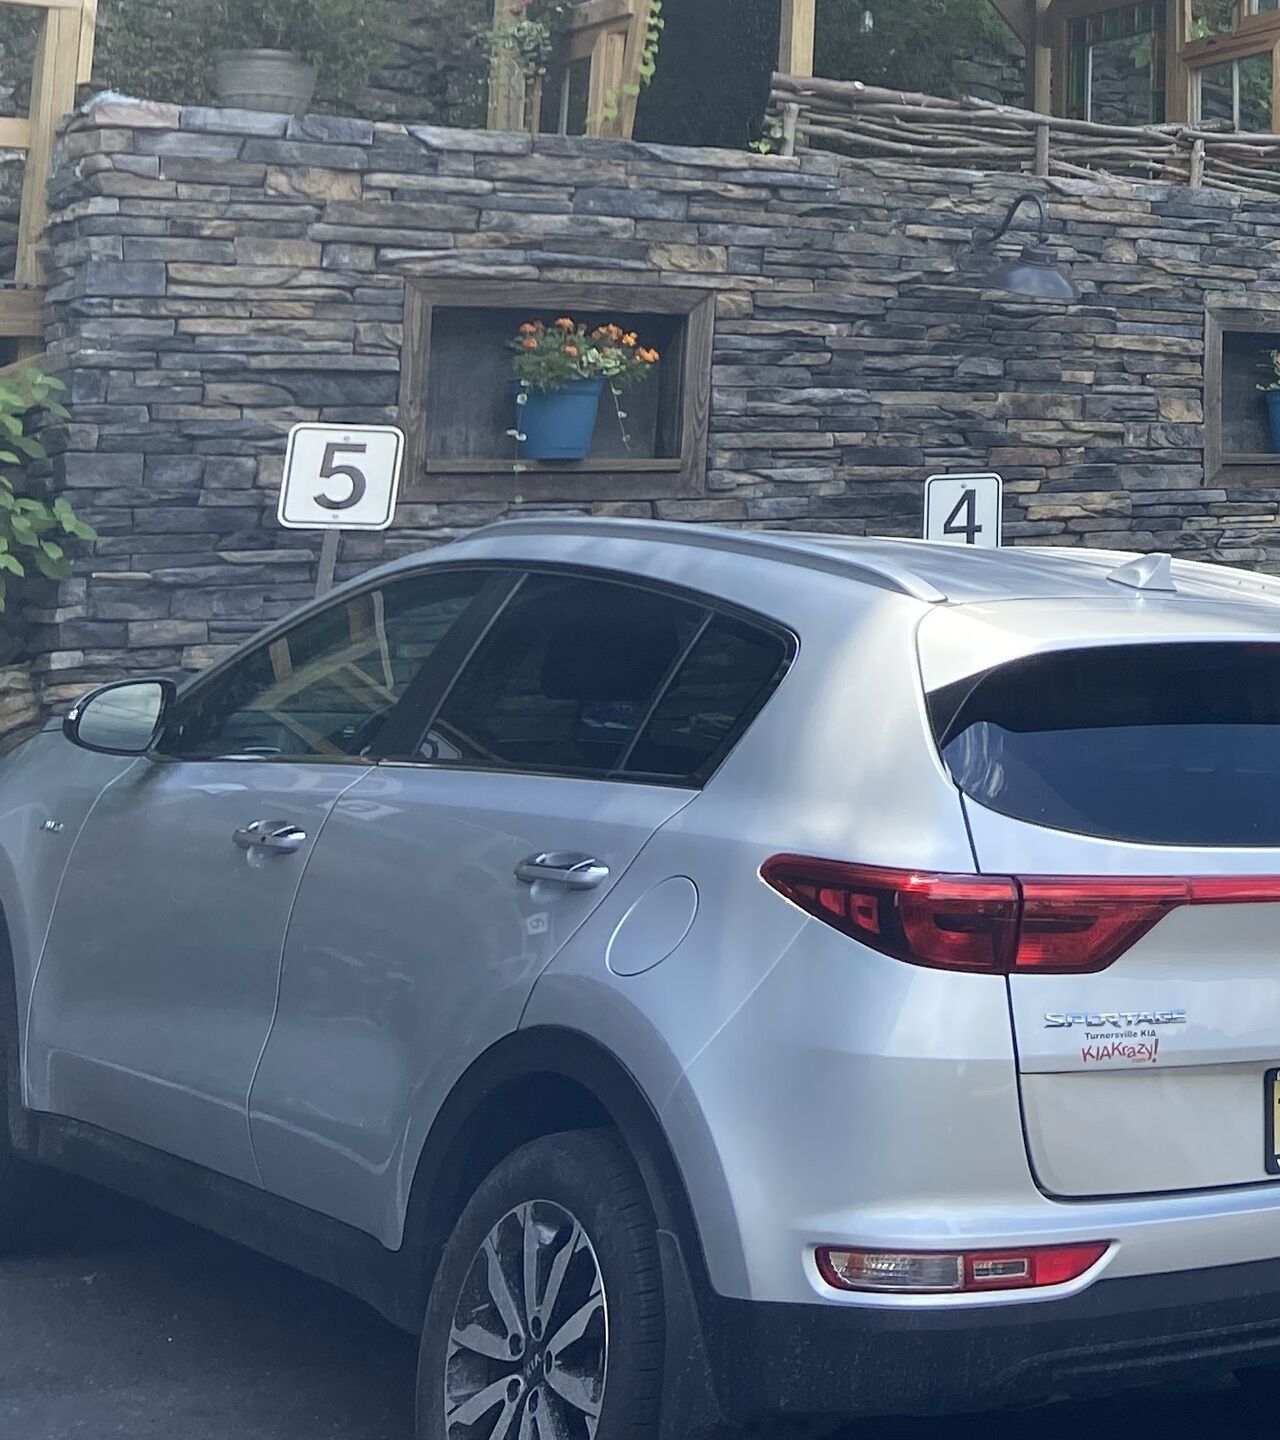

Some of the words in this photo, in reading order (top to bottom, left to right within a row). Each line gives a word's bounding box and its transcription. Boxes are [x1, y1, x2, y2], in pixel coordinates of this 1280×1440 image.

[313, 442, 367, 510] 5
[943, 489, 982, 544] 4
[1044, 1010, 1187, 1029] SPORTAGE
[1085, 1030, 1138, 1040] Turnersville
[1140, 1029, 1157, 1038] KIA
